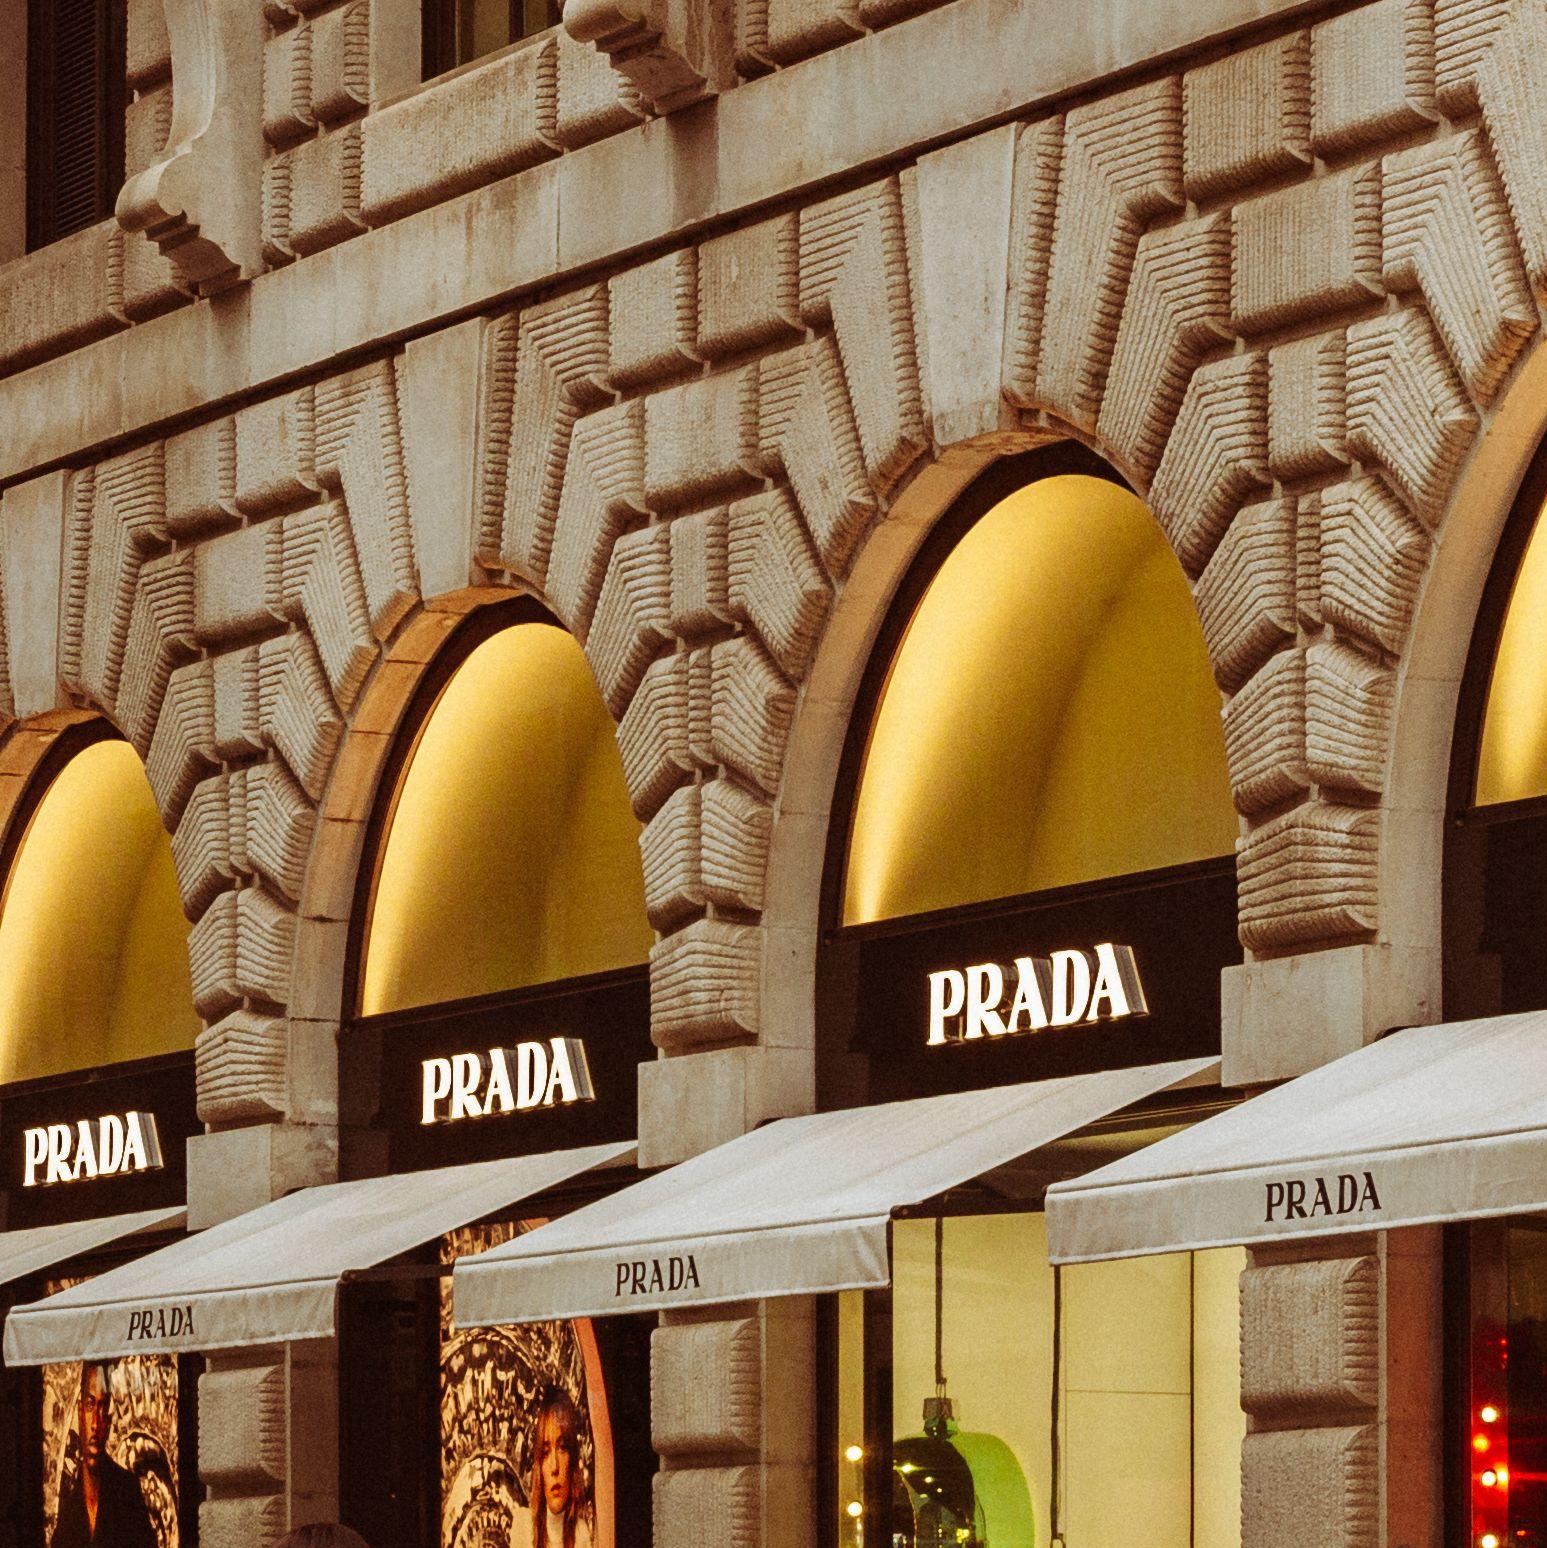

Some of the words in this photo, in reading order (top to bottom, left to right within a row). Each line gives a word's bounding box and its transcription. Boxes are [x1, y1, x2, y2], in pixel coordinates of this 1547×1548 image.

[927, 943, 1133, 1045] PRADA
[422, 1037, 578, 1124] PRADA
[23, 1111, 148, 1187] PRADA
[1264, 1171, 1383, 1223] PRADA
[614, 1254, 701, 1298] PRADA
[126, 1305, 195, 1341] PRADA
